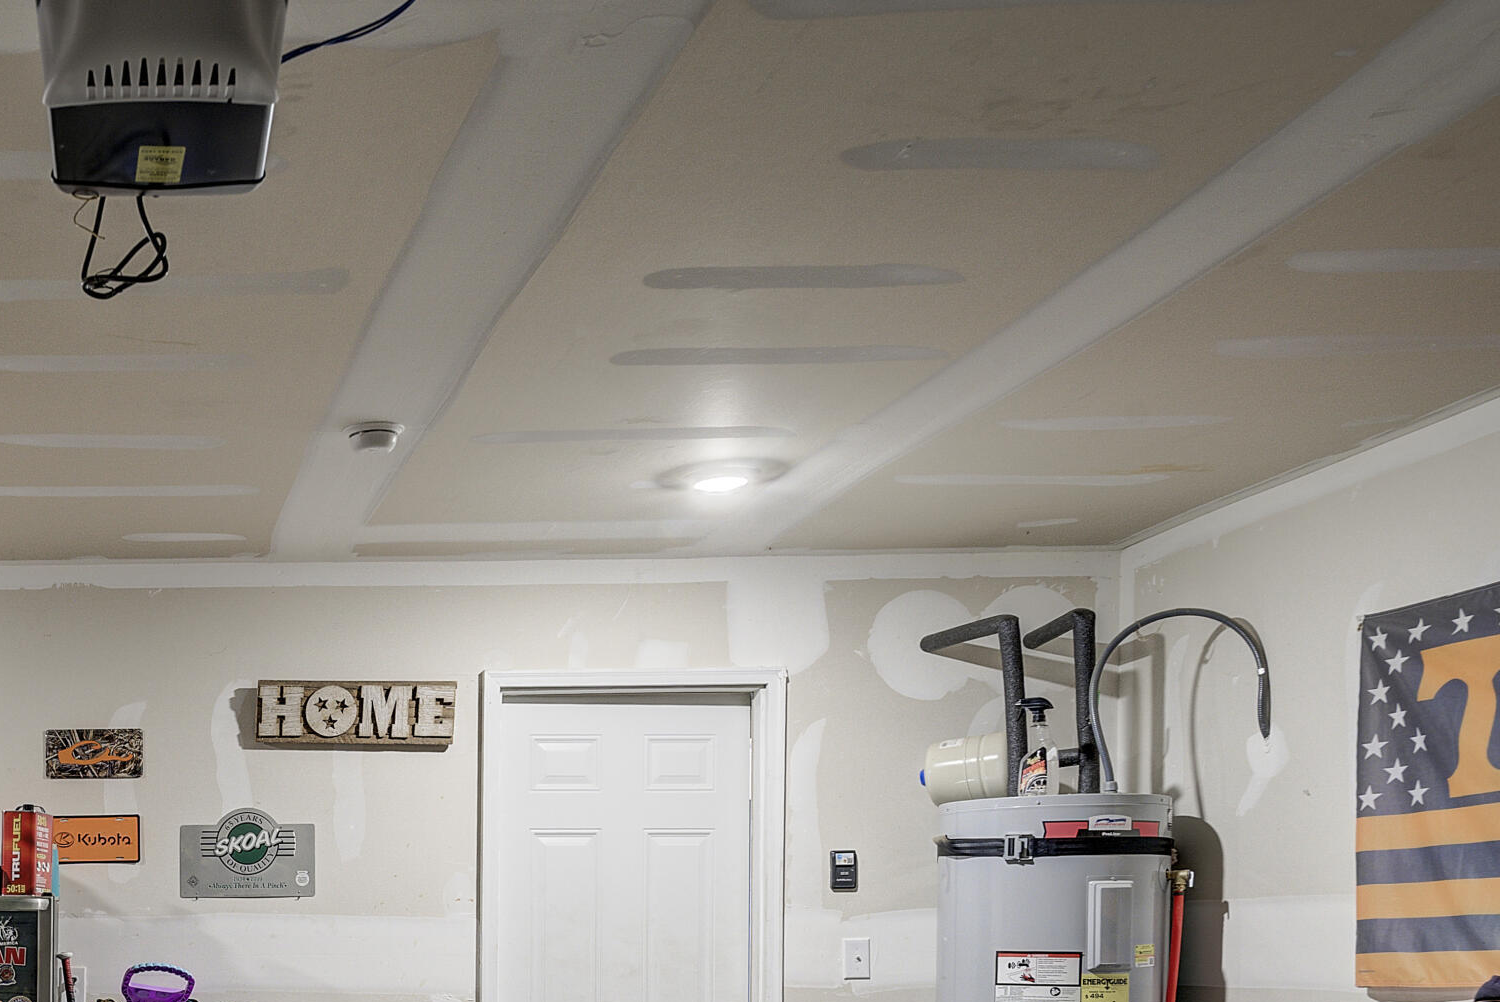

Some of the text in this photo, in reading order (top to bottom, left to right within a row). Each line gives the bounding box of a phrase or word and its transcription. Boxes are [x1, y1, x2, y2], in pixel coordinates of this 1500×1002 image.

[258, 685, 456, 738] HOME
[225, 814, 263, 831] 65 YEARS
[11, 813, 22, 881] TRUFUEL
[77, 833, 131, 846] Kubota
[214, 828, 283, 858] SKOAL
[226, 853, 274, 873] OF QUALITY
[1082, 978, 1128, 986] ENERGYGUIDE
